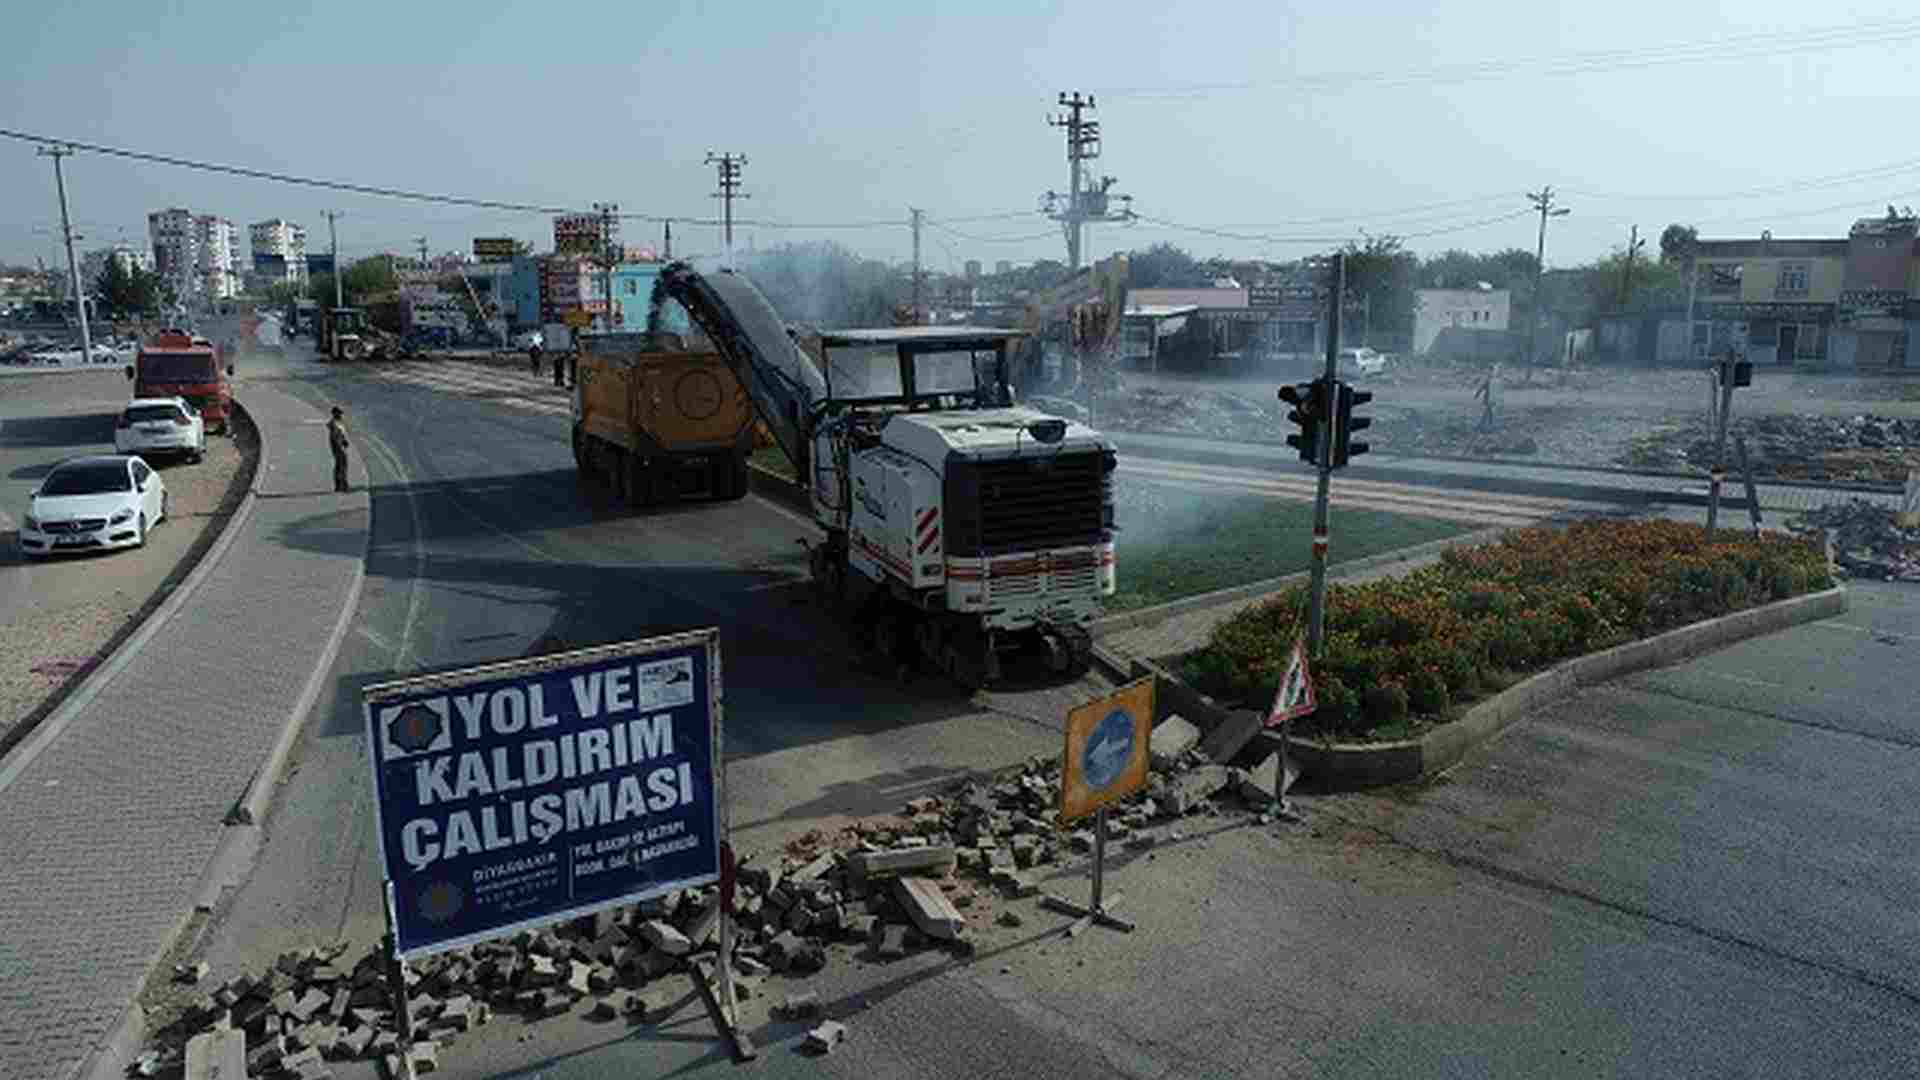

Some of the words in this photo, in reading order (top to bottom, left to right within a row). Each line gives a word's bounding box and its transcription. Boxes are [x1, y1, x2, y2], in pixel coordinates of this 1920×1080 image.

[453, 683, 559, 739] YOL
[570, 667, 633, 718] VE
[415, 713, 674, 805] KALDIRIM
[401, 761, 694, 871] ÇALIŞMASI
